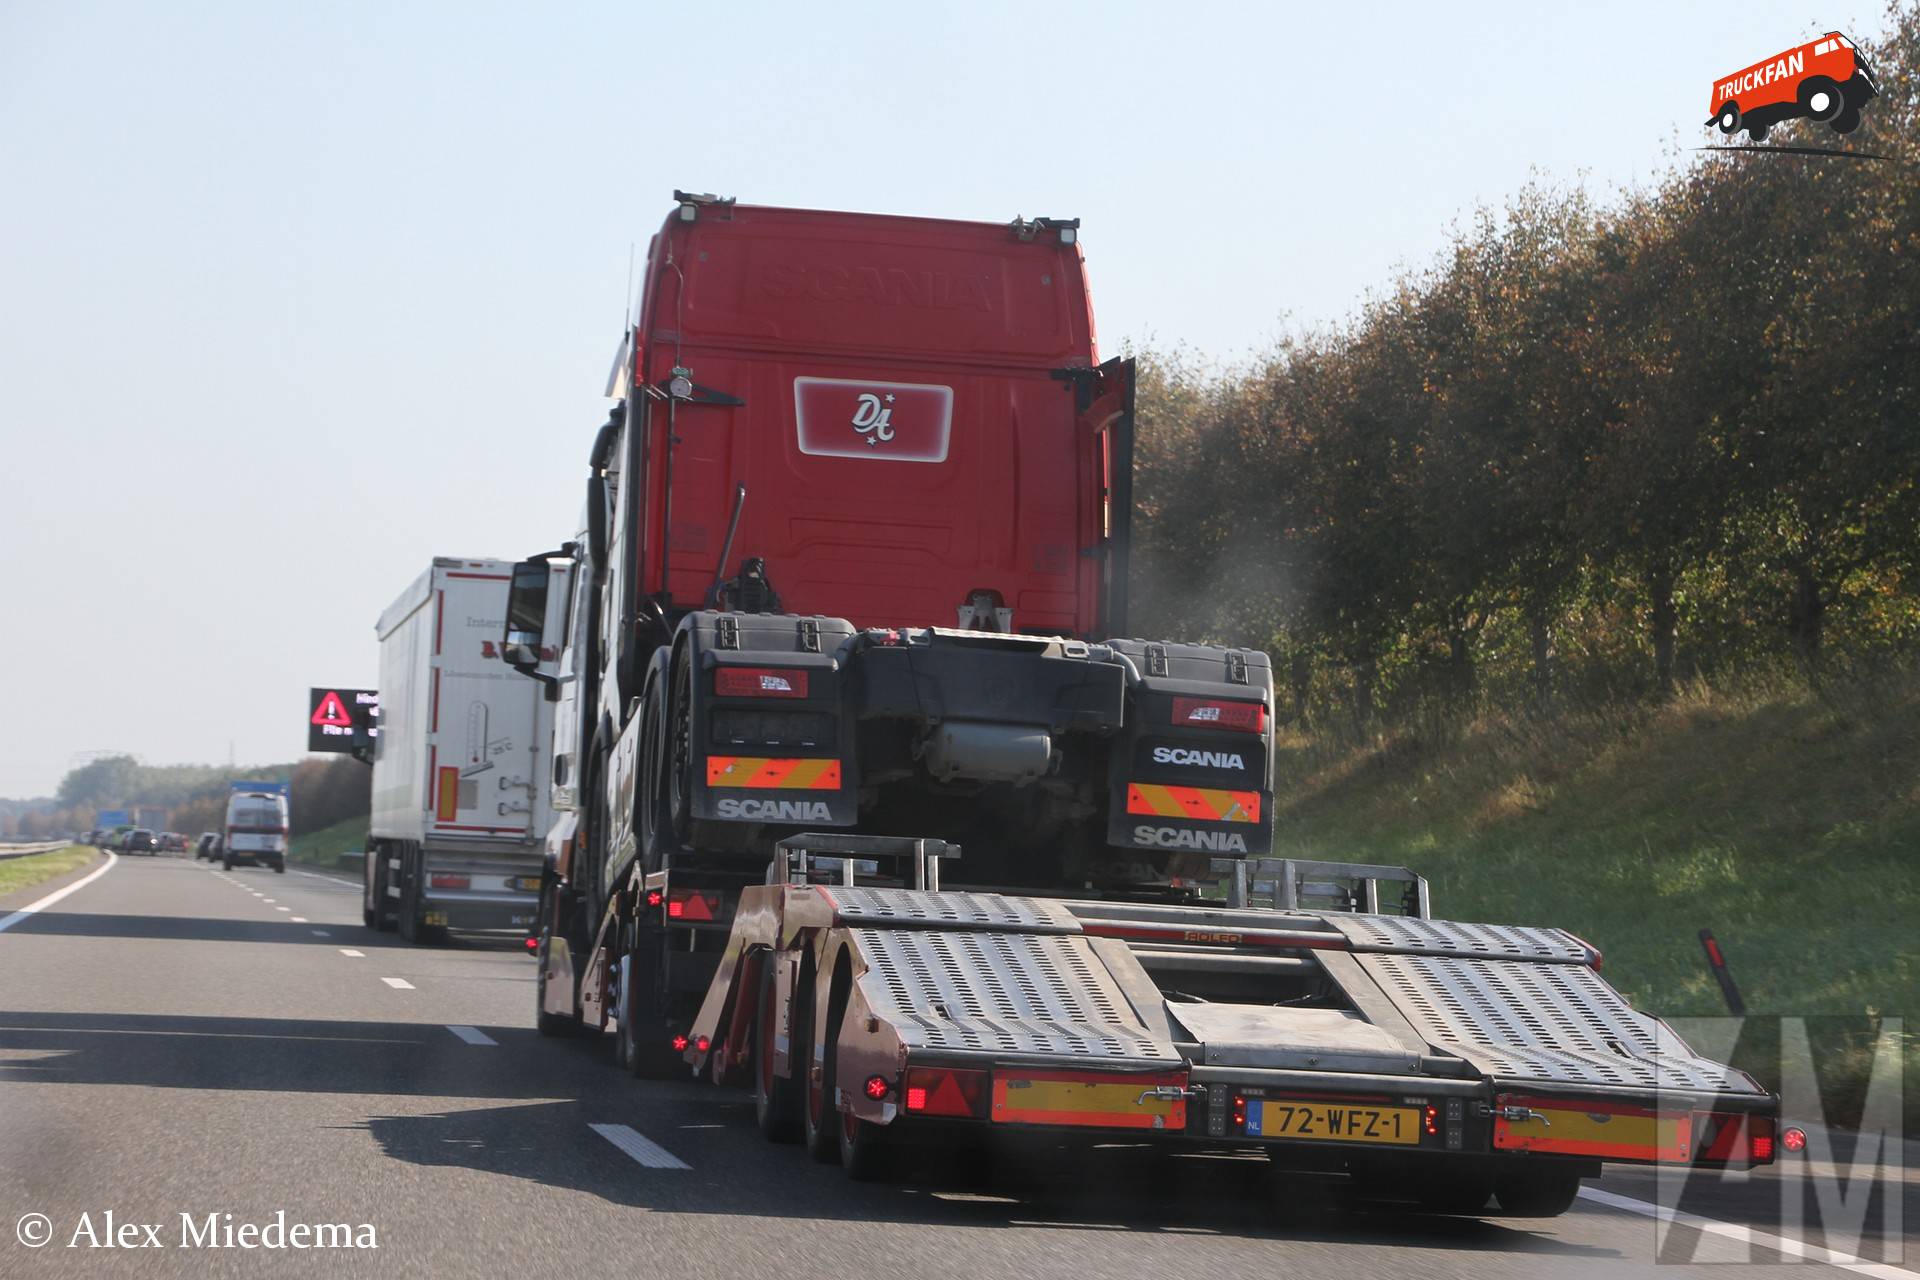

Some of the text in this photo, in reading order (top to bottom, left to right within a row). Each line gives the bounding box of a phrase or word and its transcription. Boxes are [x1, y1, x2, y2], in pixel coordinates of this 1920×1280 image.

[761, 264, 992, 312] SCANIA
[1152, 746, 1245, 770] SCANIA
[717, 798, 833, 821] SCANIA
[1133, 825, 1248, 853] SCANIA
[1247, 1106, 1400, 1138] NL 72-WFZ-1
